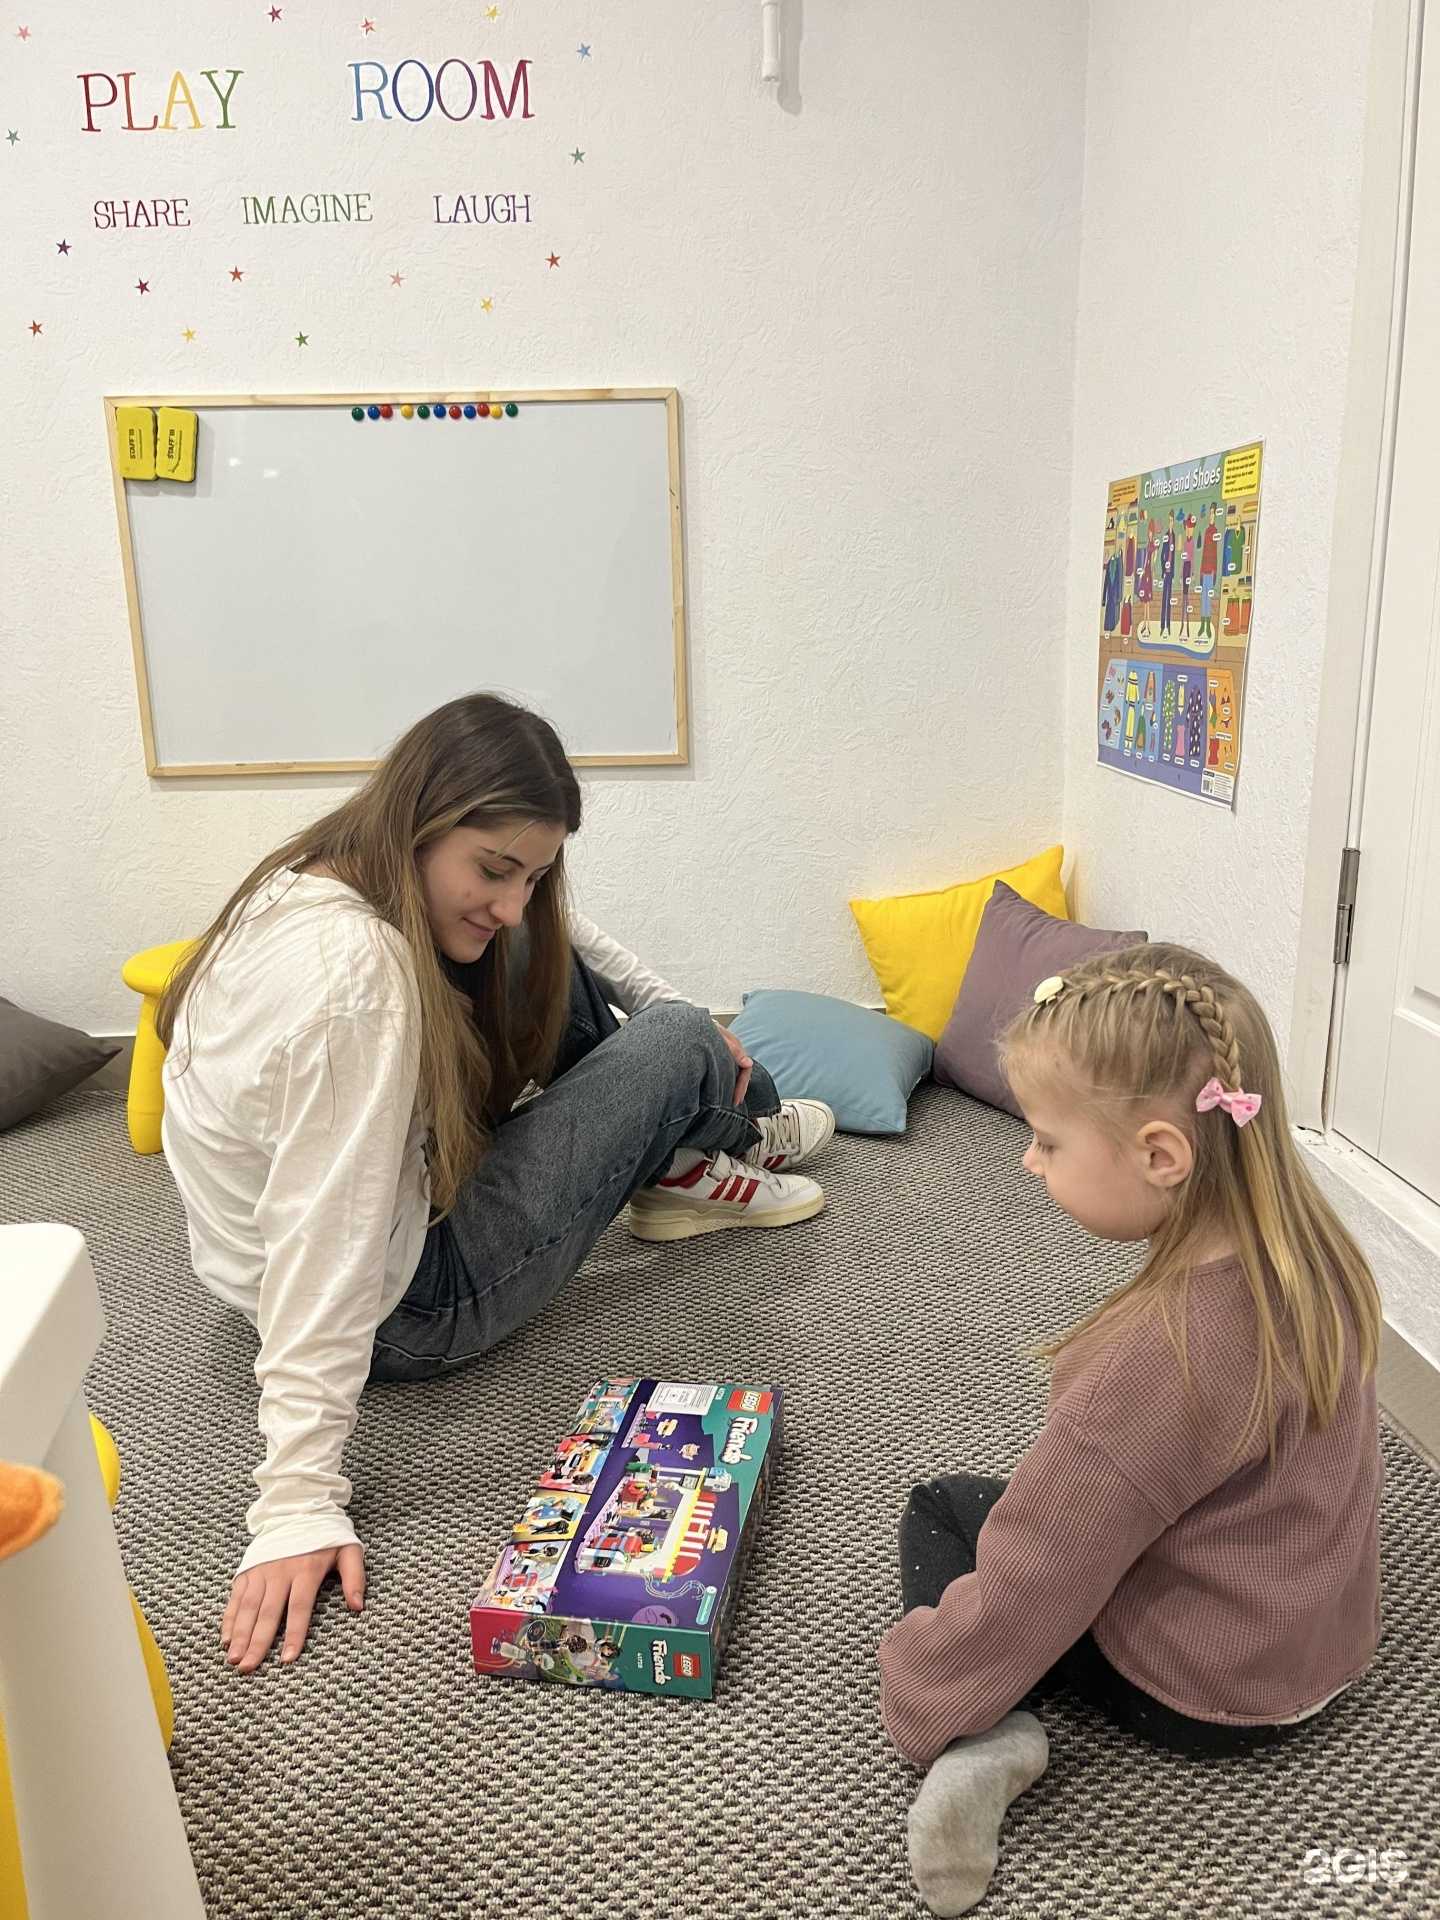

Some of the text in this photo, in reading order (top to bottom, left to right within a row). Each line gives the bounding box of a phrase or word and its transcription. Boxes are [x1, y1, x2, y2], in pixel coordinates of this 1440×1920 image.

[77, 59, 535, 132] PLAY ROOM
[94, 193, 532, 229] SHARE IMAGINE LAUGH
[128, 437, 136, 459] STAFF
[167, 437, 175, 459] STAFF
[1144, 476, 1172, 500] Clothes
[1173, 473, 1190, 494] and
[1192, 466, 1221, 488] Shoes
[740, 1391, 762, 1412] LEGO
[721, 1417, 758, 1464] Friends
[653, 1640, 672, 1685] Friends
[681, 1655, 693, 1676] LEGO
